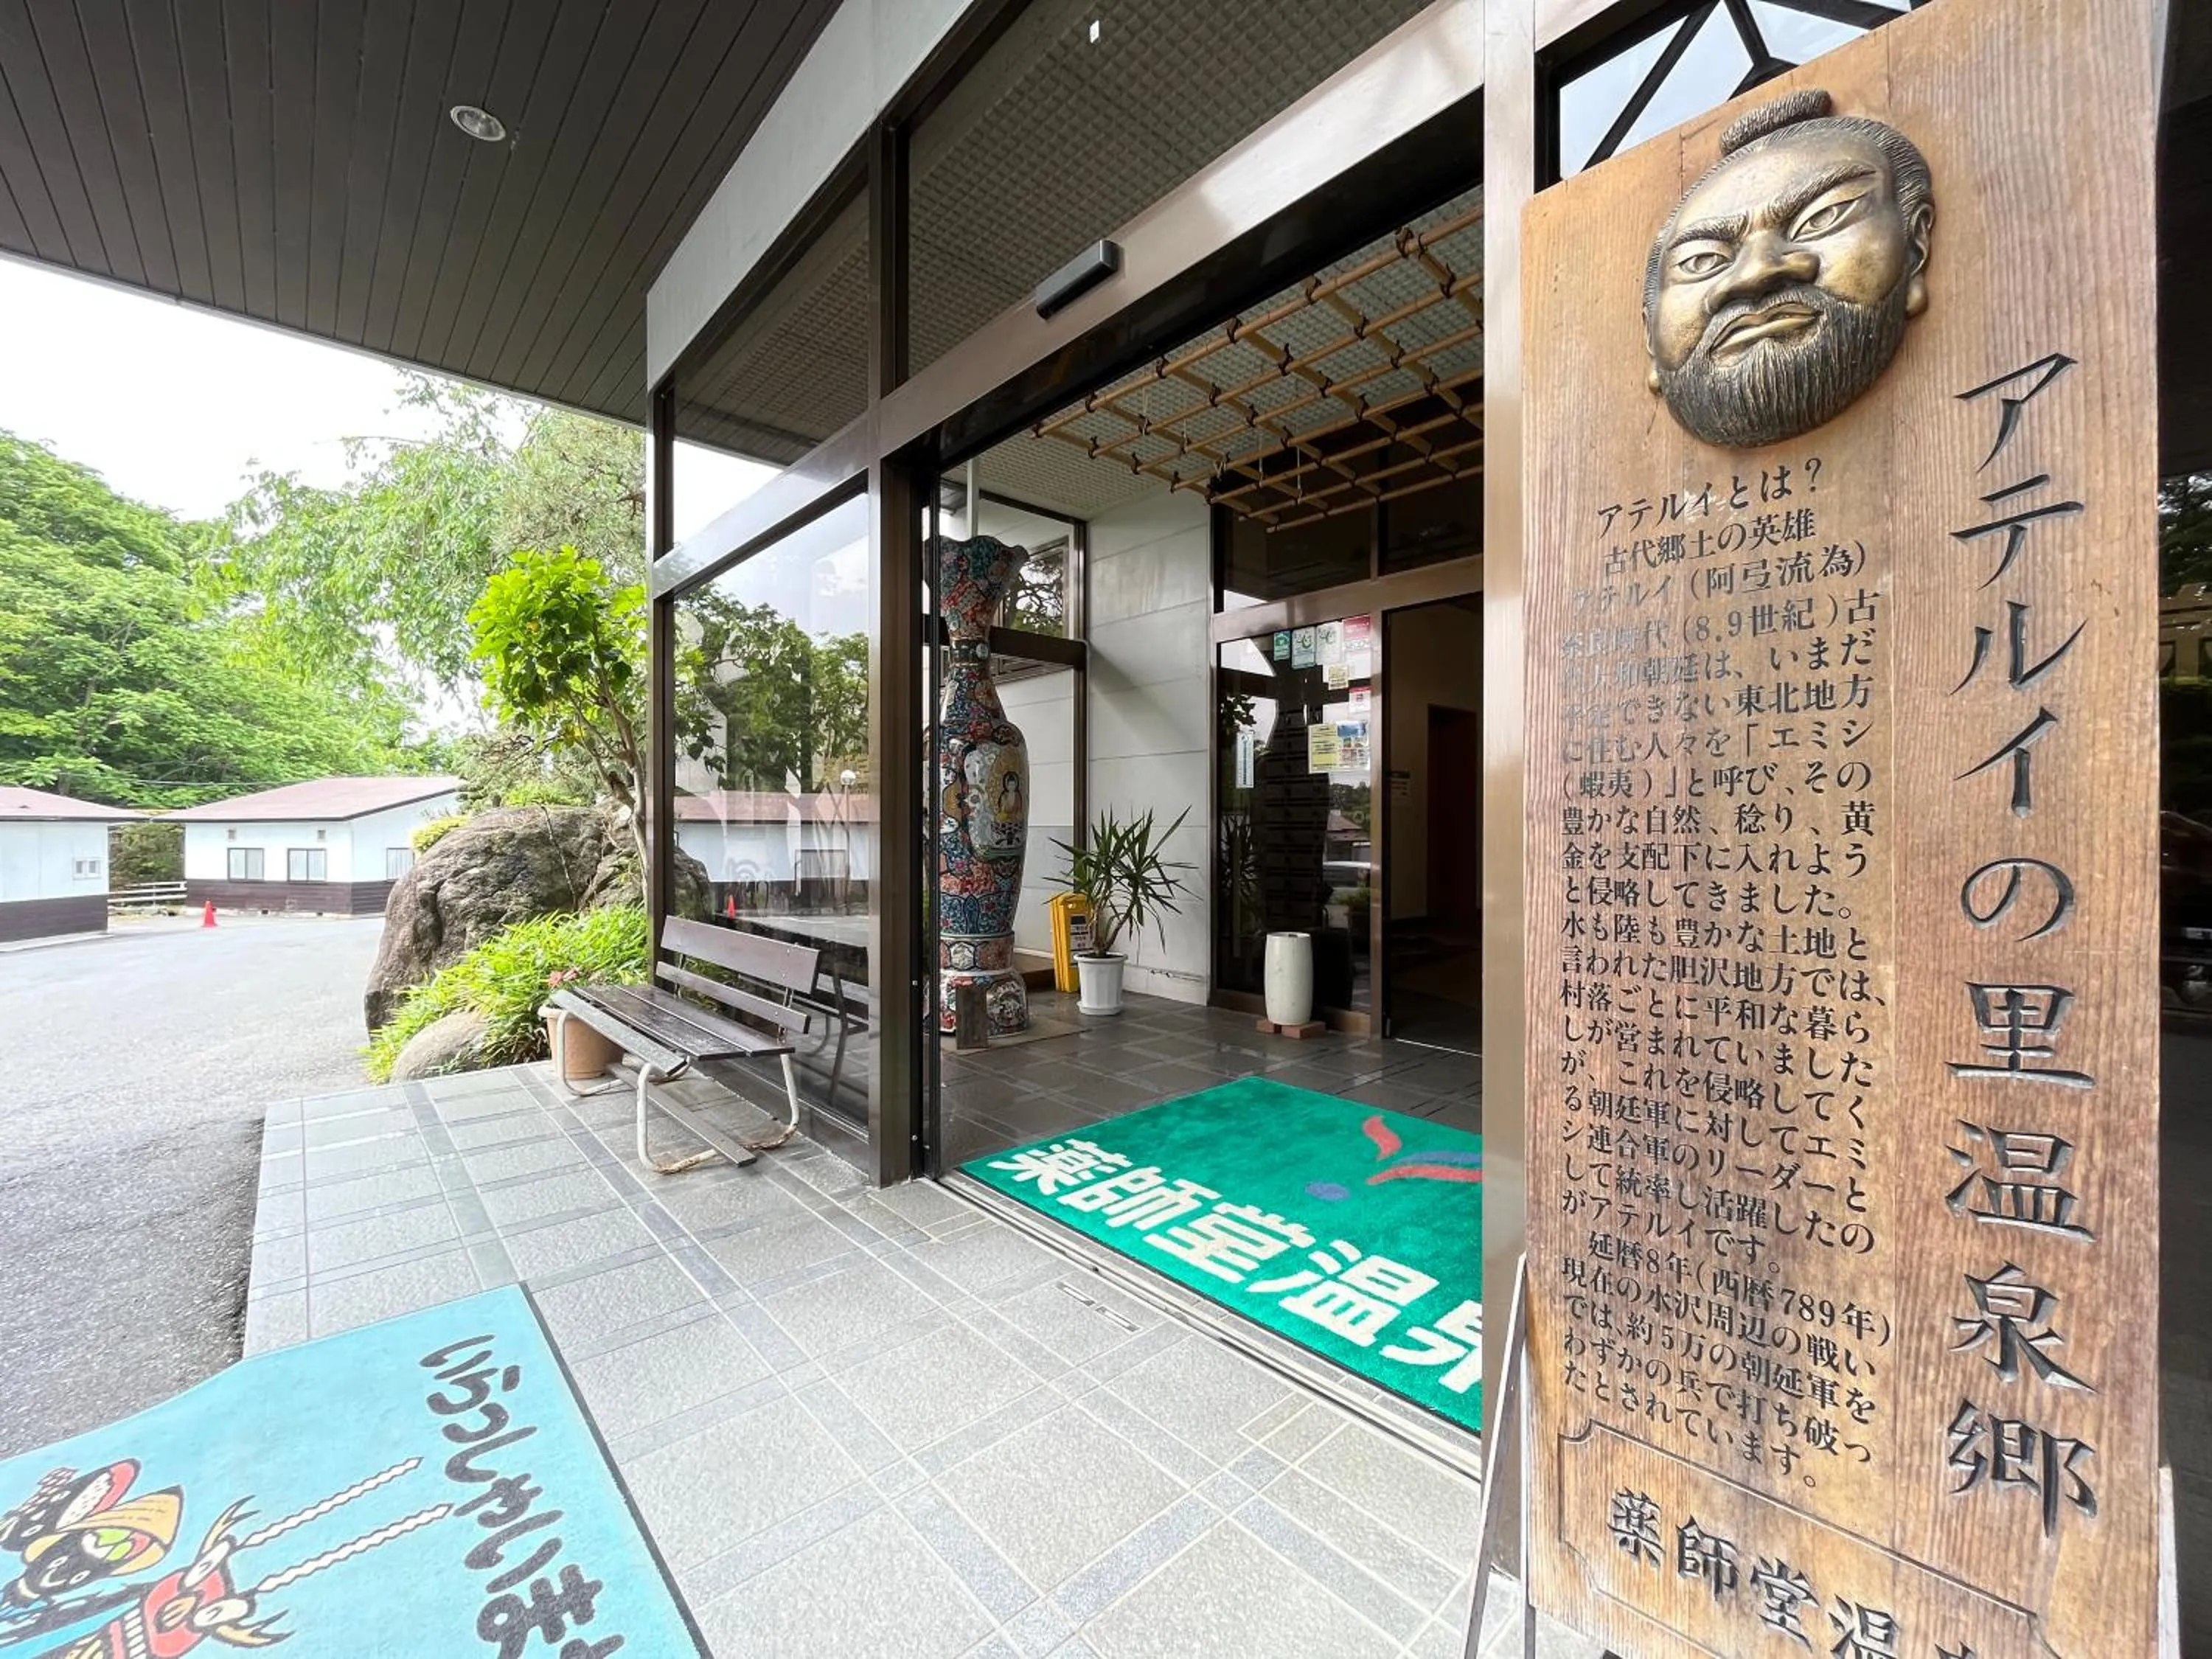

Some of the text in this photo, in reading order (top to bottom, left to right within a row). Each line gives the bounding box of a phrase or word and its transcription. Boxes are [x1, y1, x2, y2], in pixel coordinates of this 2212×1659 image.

[1597, 457, 1823, 538] アテルイとは？
[1604, 508, 1817, 578] 古代郷土の英雄
[1561, 842, 1868, 877] 金を支配下に入れよう
[1564, 876, 1851, 920] と侵略してきました。
[1561, 911, 1868, 961] 水も陸も豊かな土地と
[1561, 945, 1886, 1006] 言われた胆沢地方では、
[1945, 352, 2098, 1539] アテルイの里温泉郷
[1559, 979, 1870, 1045] 村落ごとに平和な暮ら
[1564, 1015, 1872, 1088] しが営まれていました
[1560, 1048, 1866, 1131] が、これを侵略してく
[1563, 1083, 1867, 1170] る朝廷軍に対してエミ
[1561, 1119, 1867, 1213] シ連合軍のリーダーと
[1565, 1152, 1876, 1254] して統率し活躍したの
[1561, 1189, 1781, 1274] がアテルイです。
[1561, 1256, 1876, 1377] 現在の水沢周辺の戦い
[1564, 1325, 1871, 1464] わずかの兵で打ち破っ
[1564, 1360, 1817, 1488] たとされています。
[419, 1334, 625, 1659] いらっしゃいま
[1606, 1485, 1977, 1659] 薬師堂温
